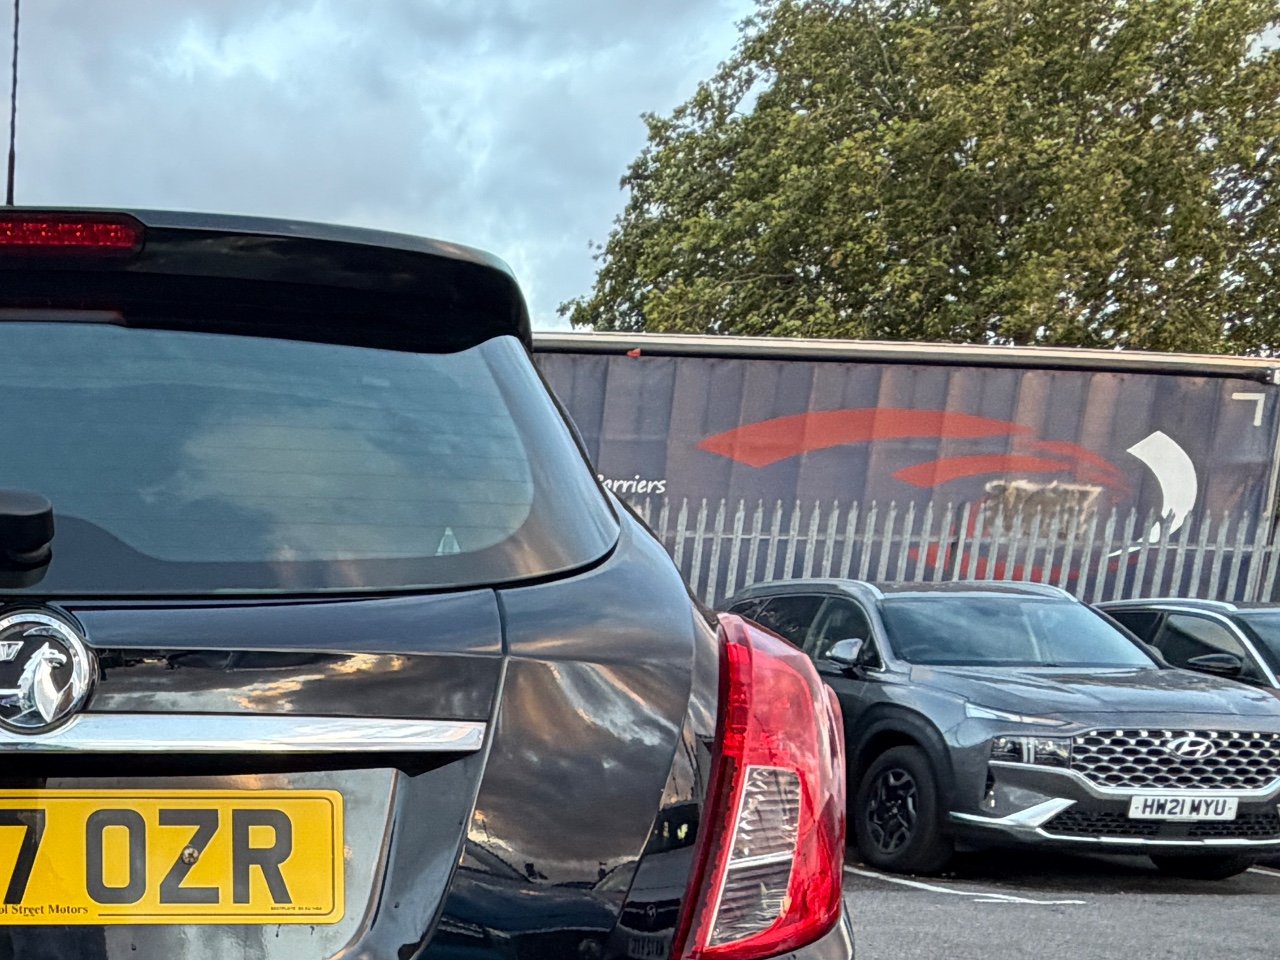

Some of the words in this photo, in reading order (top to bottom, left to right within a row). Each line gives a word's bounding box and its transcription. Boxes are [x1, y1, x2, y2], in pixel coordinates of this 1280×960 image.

[1141, 798, 1186, 815] HW21
[1188, 799, 1227, 816] MYU
[85, 807, 294, 906] OZR
[11, 904, 45, 915] Street
[48, 904, 89, 915] Motors
